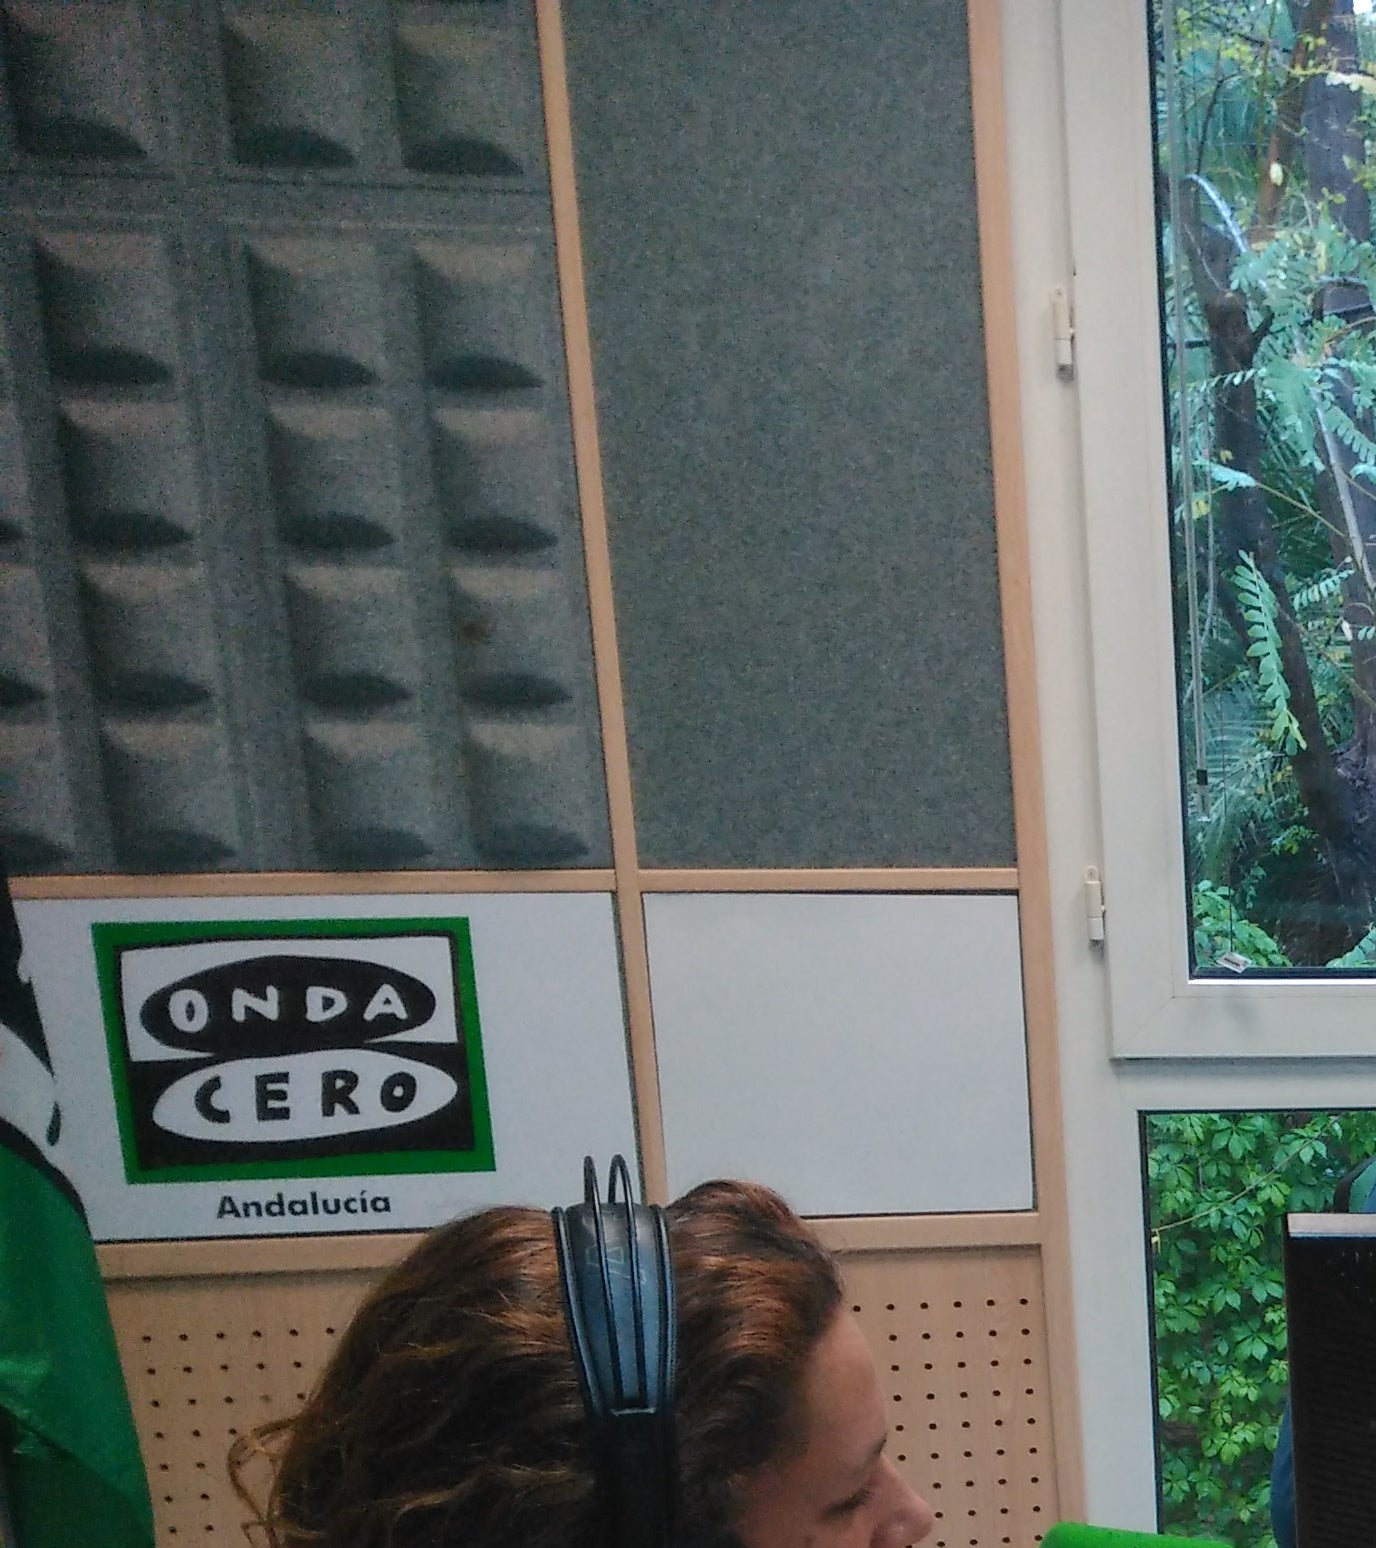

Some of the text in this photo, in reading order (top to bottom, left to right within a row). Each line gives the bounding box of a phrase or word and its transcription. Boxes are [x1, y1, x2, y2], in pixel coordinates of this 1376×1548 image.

[167, 984, 409, 1033] ONDA
[194, 1068, 418, 1124] CERO
[216, 1190, 391, 1220] Andalucía
